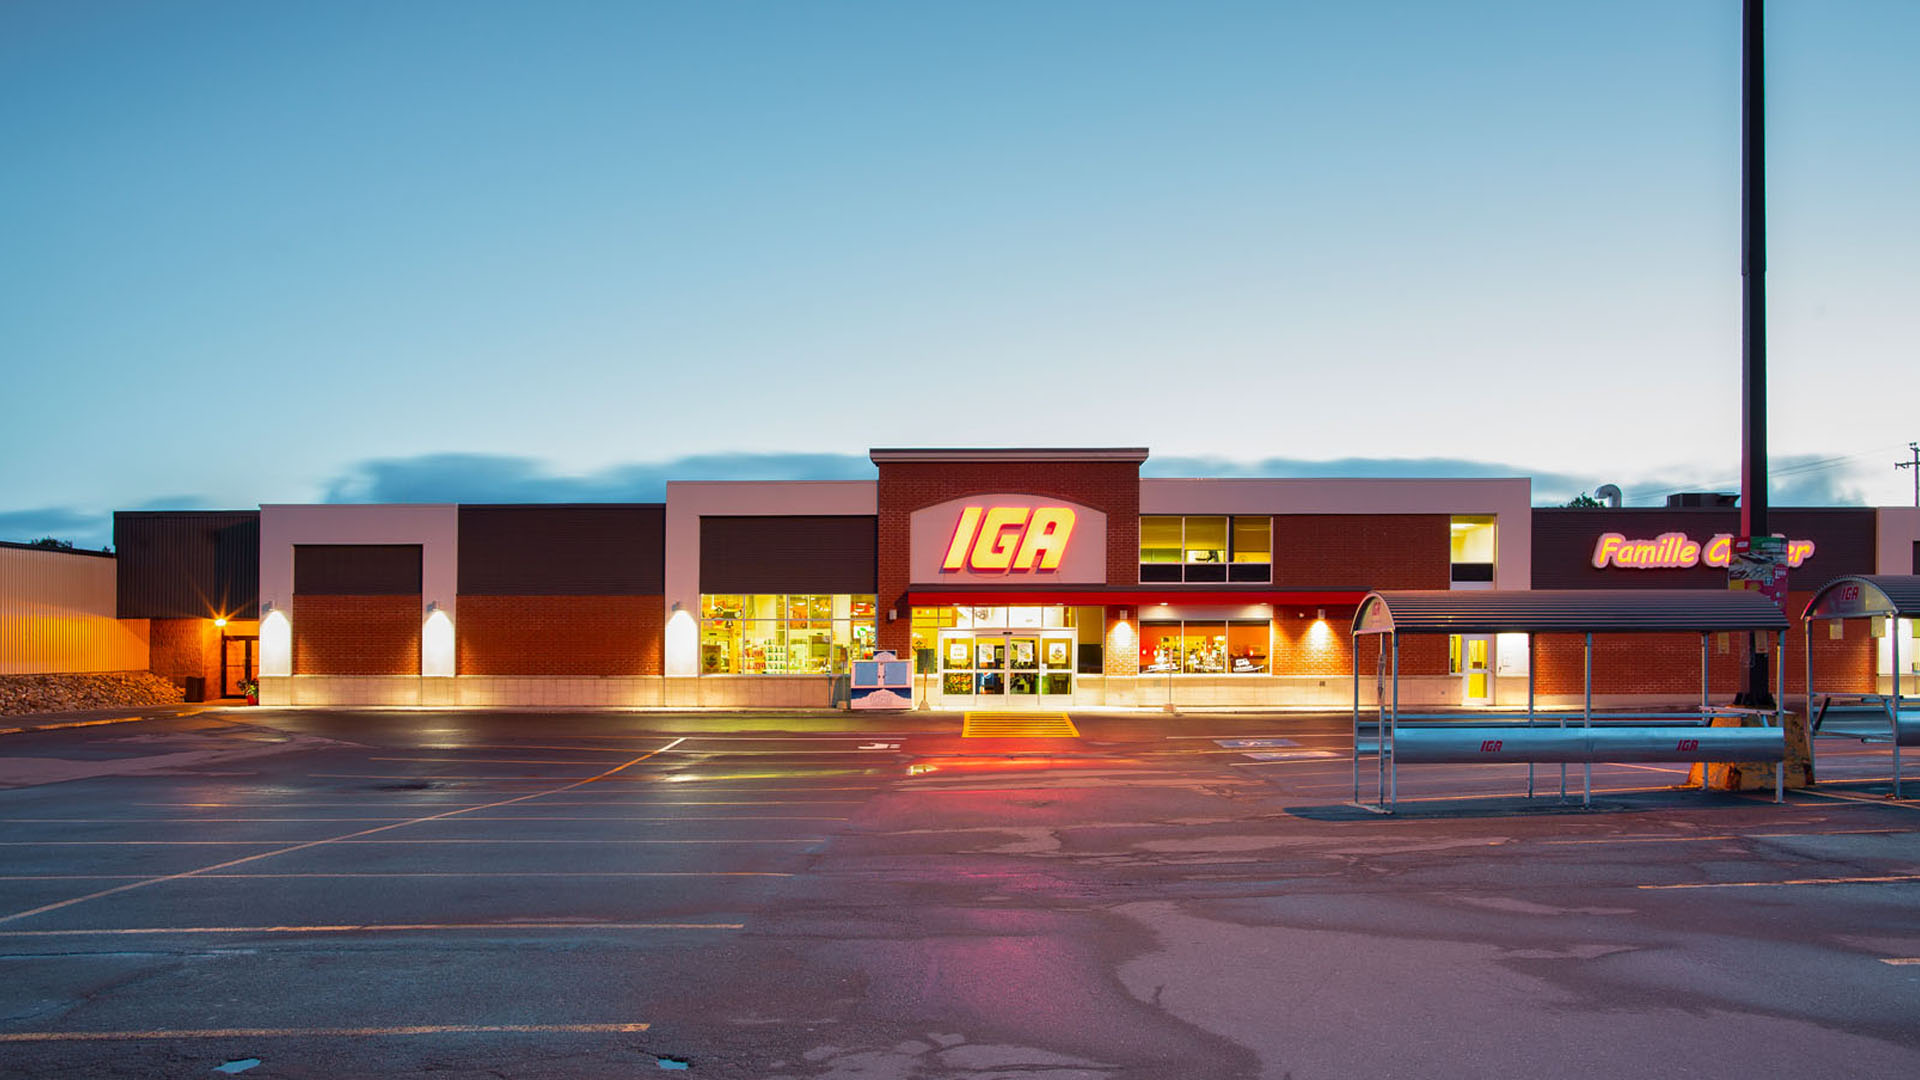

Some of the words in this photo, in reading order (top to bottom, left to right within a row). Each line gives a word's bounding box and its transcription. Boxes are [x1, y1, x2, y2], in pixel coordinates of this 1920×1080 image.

[942, 506, 1077, 570] IGA
[1596, 534, 1698, 565] Famille
[1842, 586, 1859, 600] IGA
[1480, 740, 1503, 752] IGA
[1677, 739, 1699, 752] IGA
